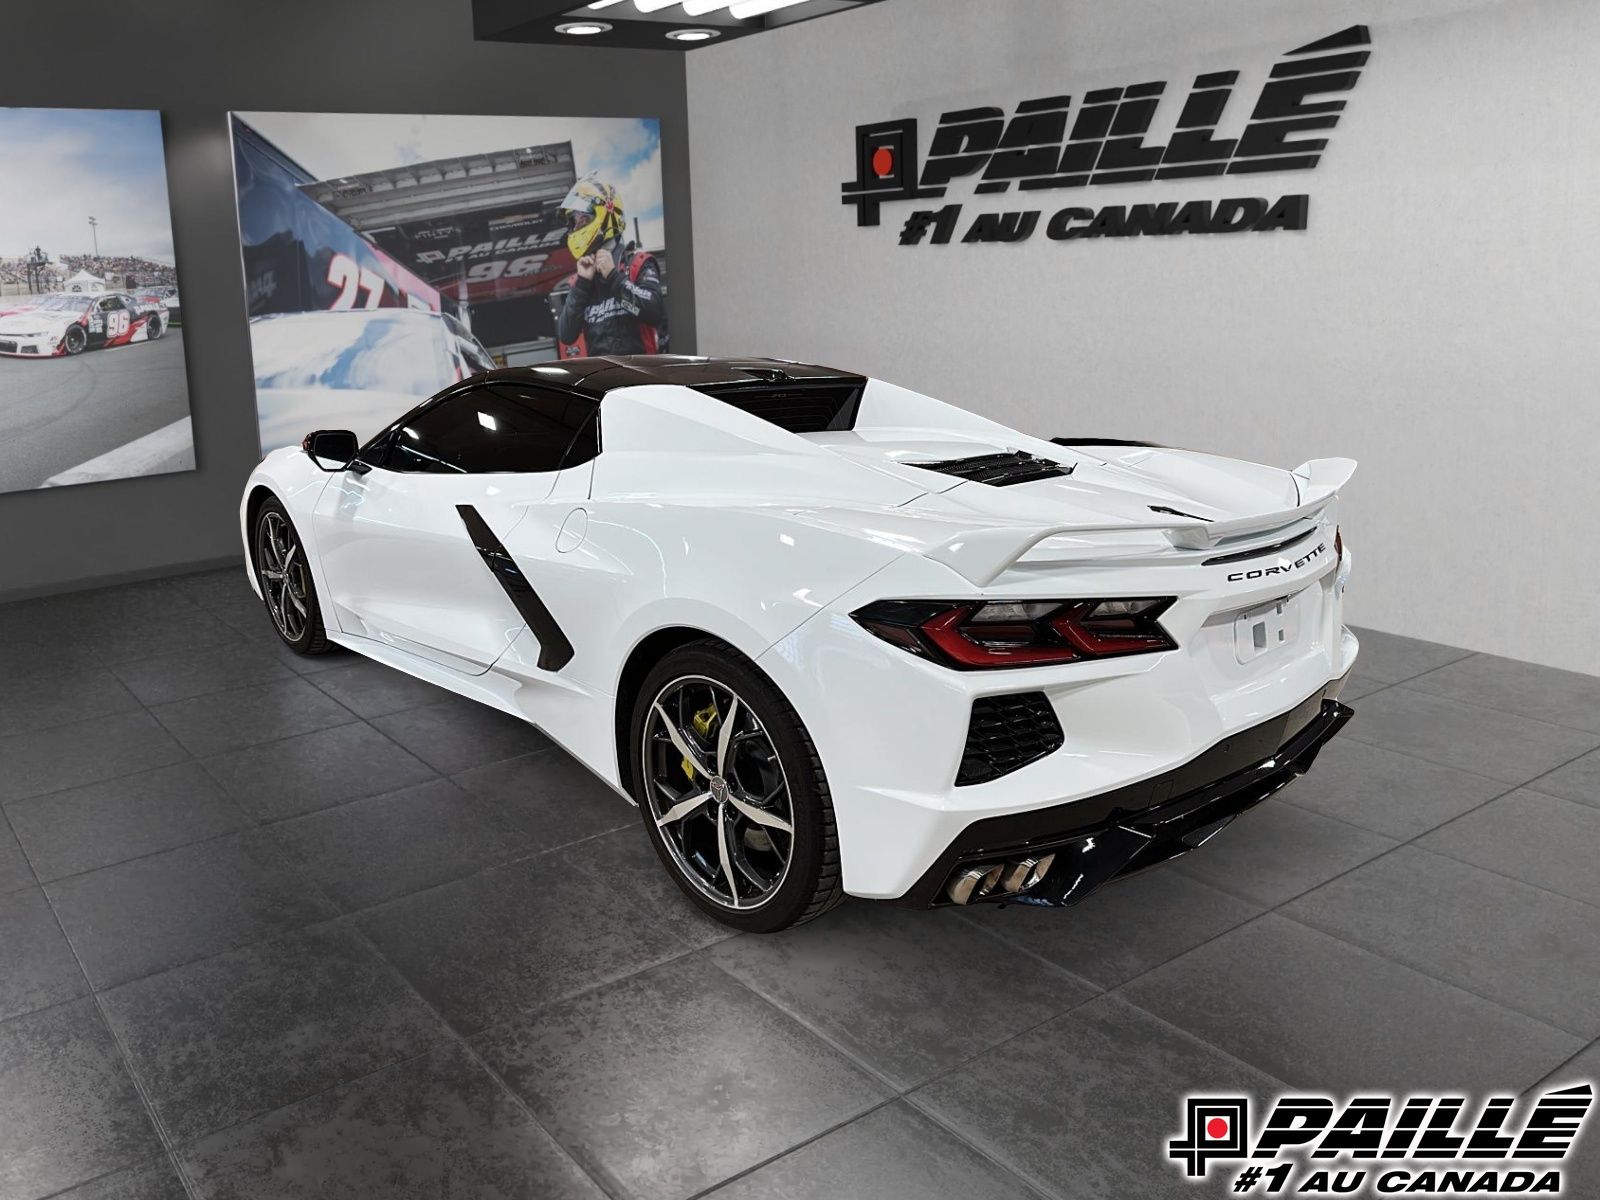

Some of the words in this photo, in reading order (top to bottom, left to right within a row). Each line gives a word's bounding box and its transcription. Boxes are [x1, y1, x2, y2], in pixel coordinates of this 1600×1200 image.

[919, 24, 1371, 196] PAILLÉ
[899, 204, 963, 246] #1
[961, 211, 1041, 244] AU
[1046, 194, 1310, 241] CANADA
[326, 253, 385, 311] 27
[467, 253, 550, 284] 96
[106, 308, 130, 338] 96
[1227, 542, 1326, 582] CORVETTE
